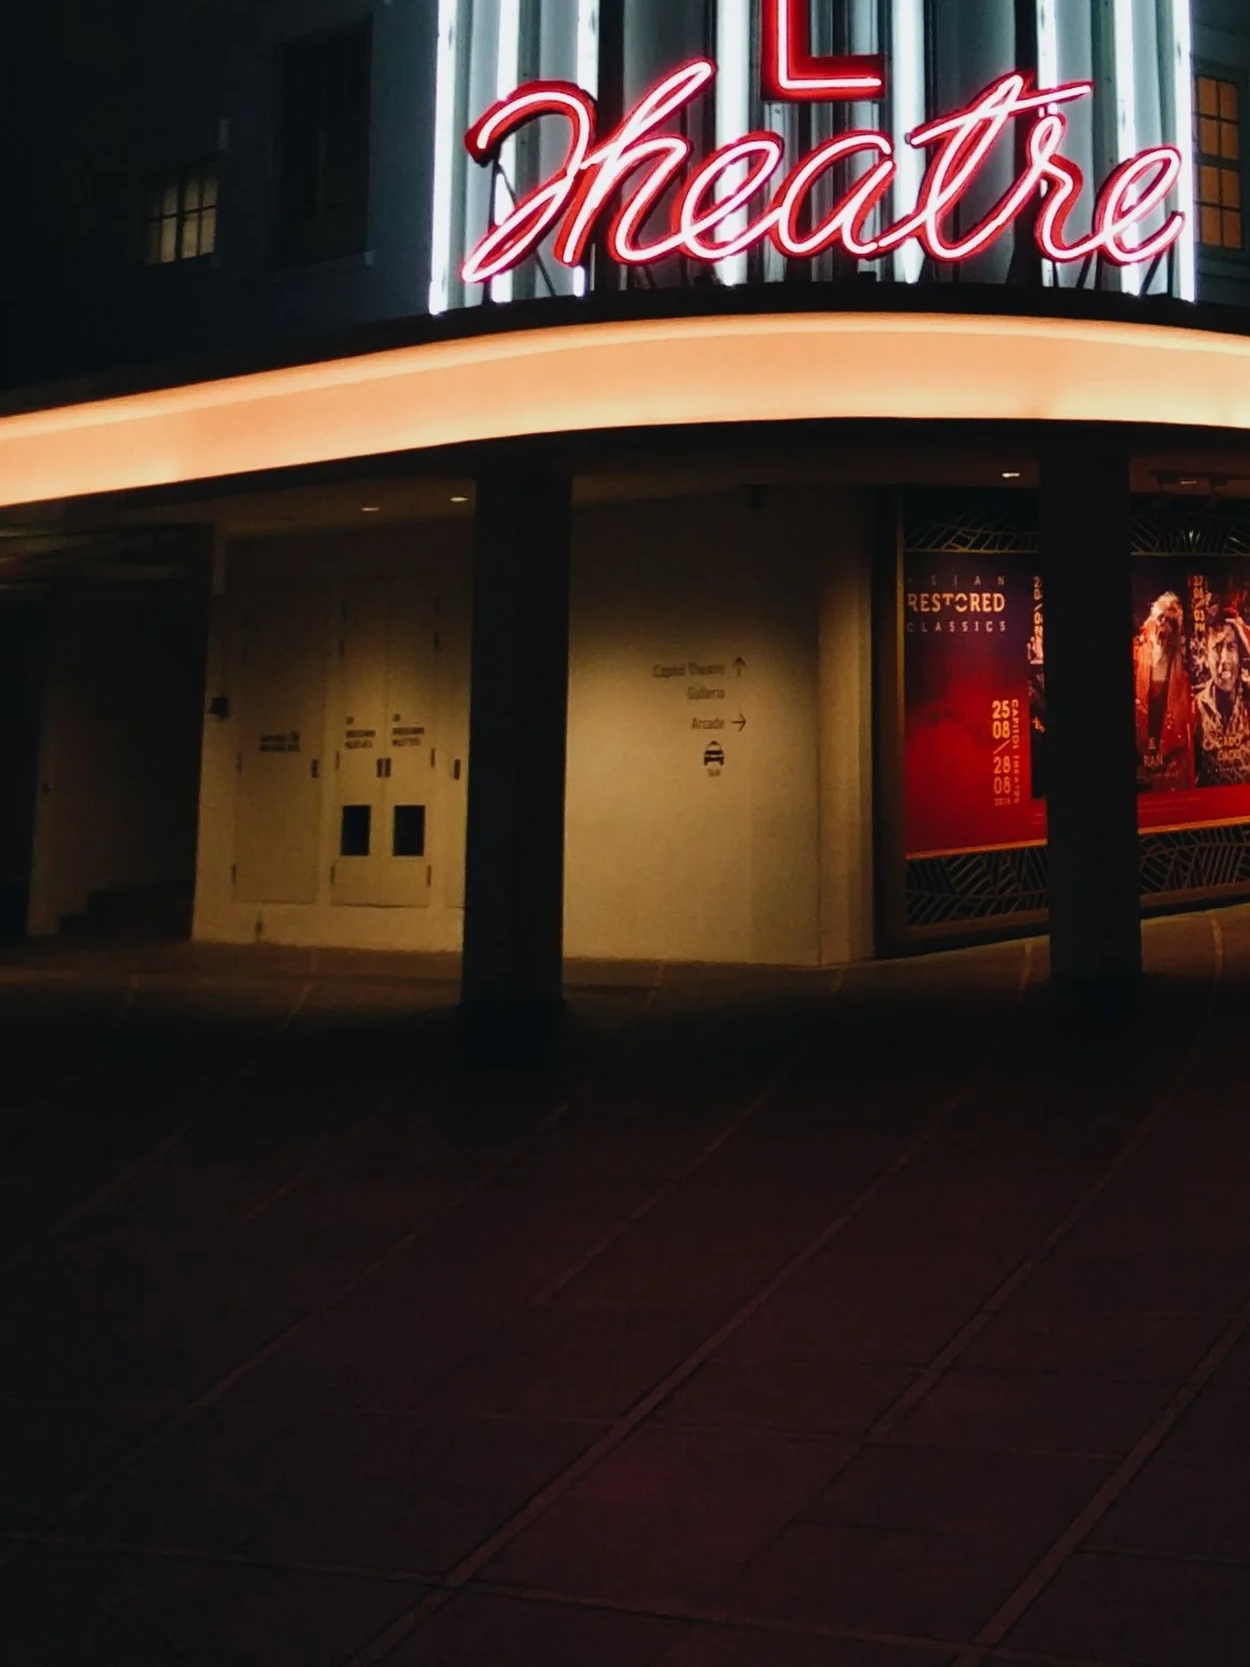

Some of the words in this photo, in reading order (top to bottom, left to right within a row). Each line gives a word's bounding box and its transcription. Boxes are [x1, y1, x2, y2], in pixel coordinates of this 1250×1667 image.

[462, 59, 1190, 285] Theatre
[906, 592, 1006, 613] RESTORED
[906, 620, 1007, 633] CLASSICS
[991, 699, 1010, 719] 25
[690, 717, 725, 730] Arcade
[992, 720, 1011, 740] 08
[993, 755, 1012, 774] 28
[993, 775, 1012, 795] 08
